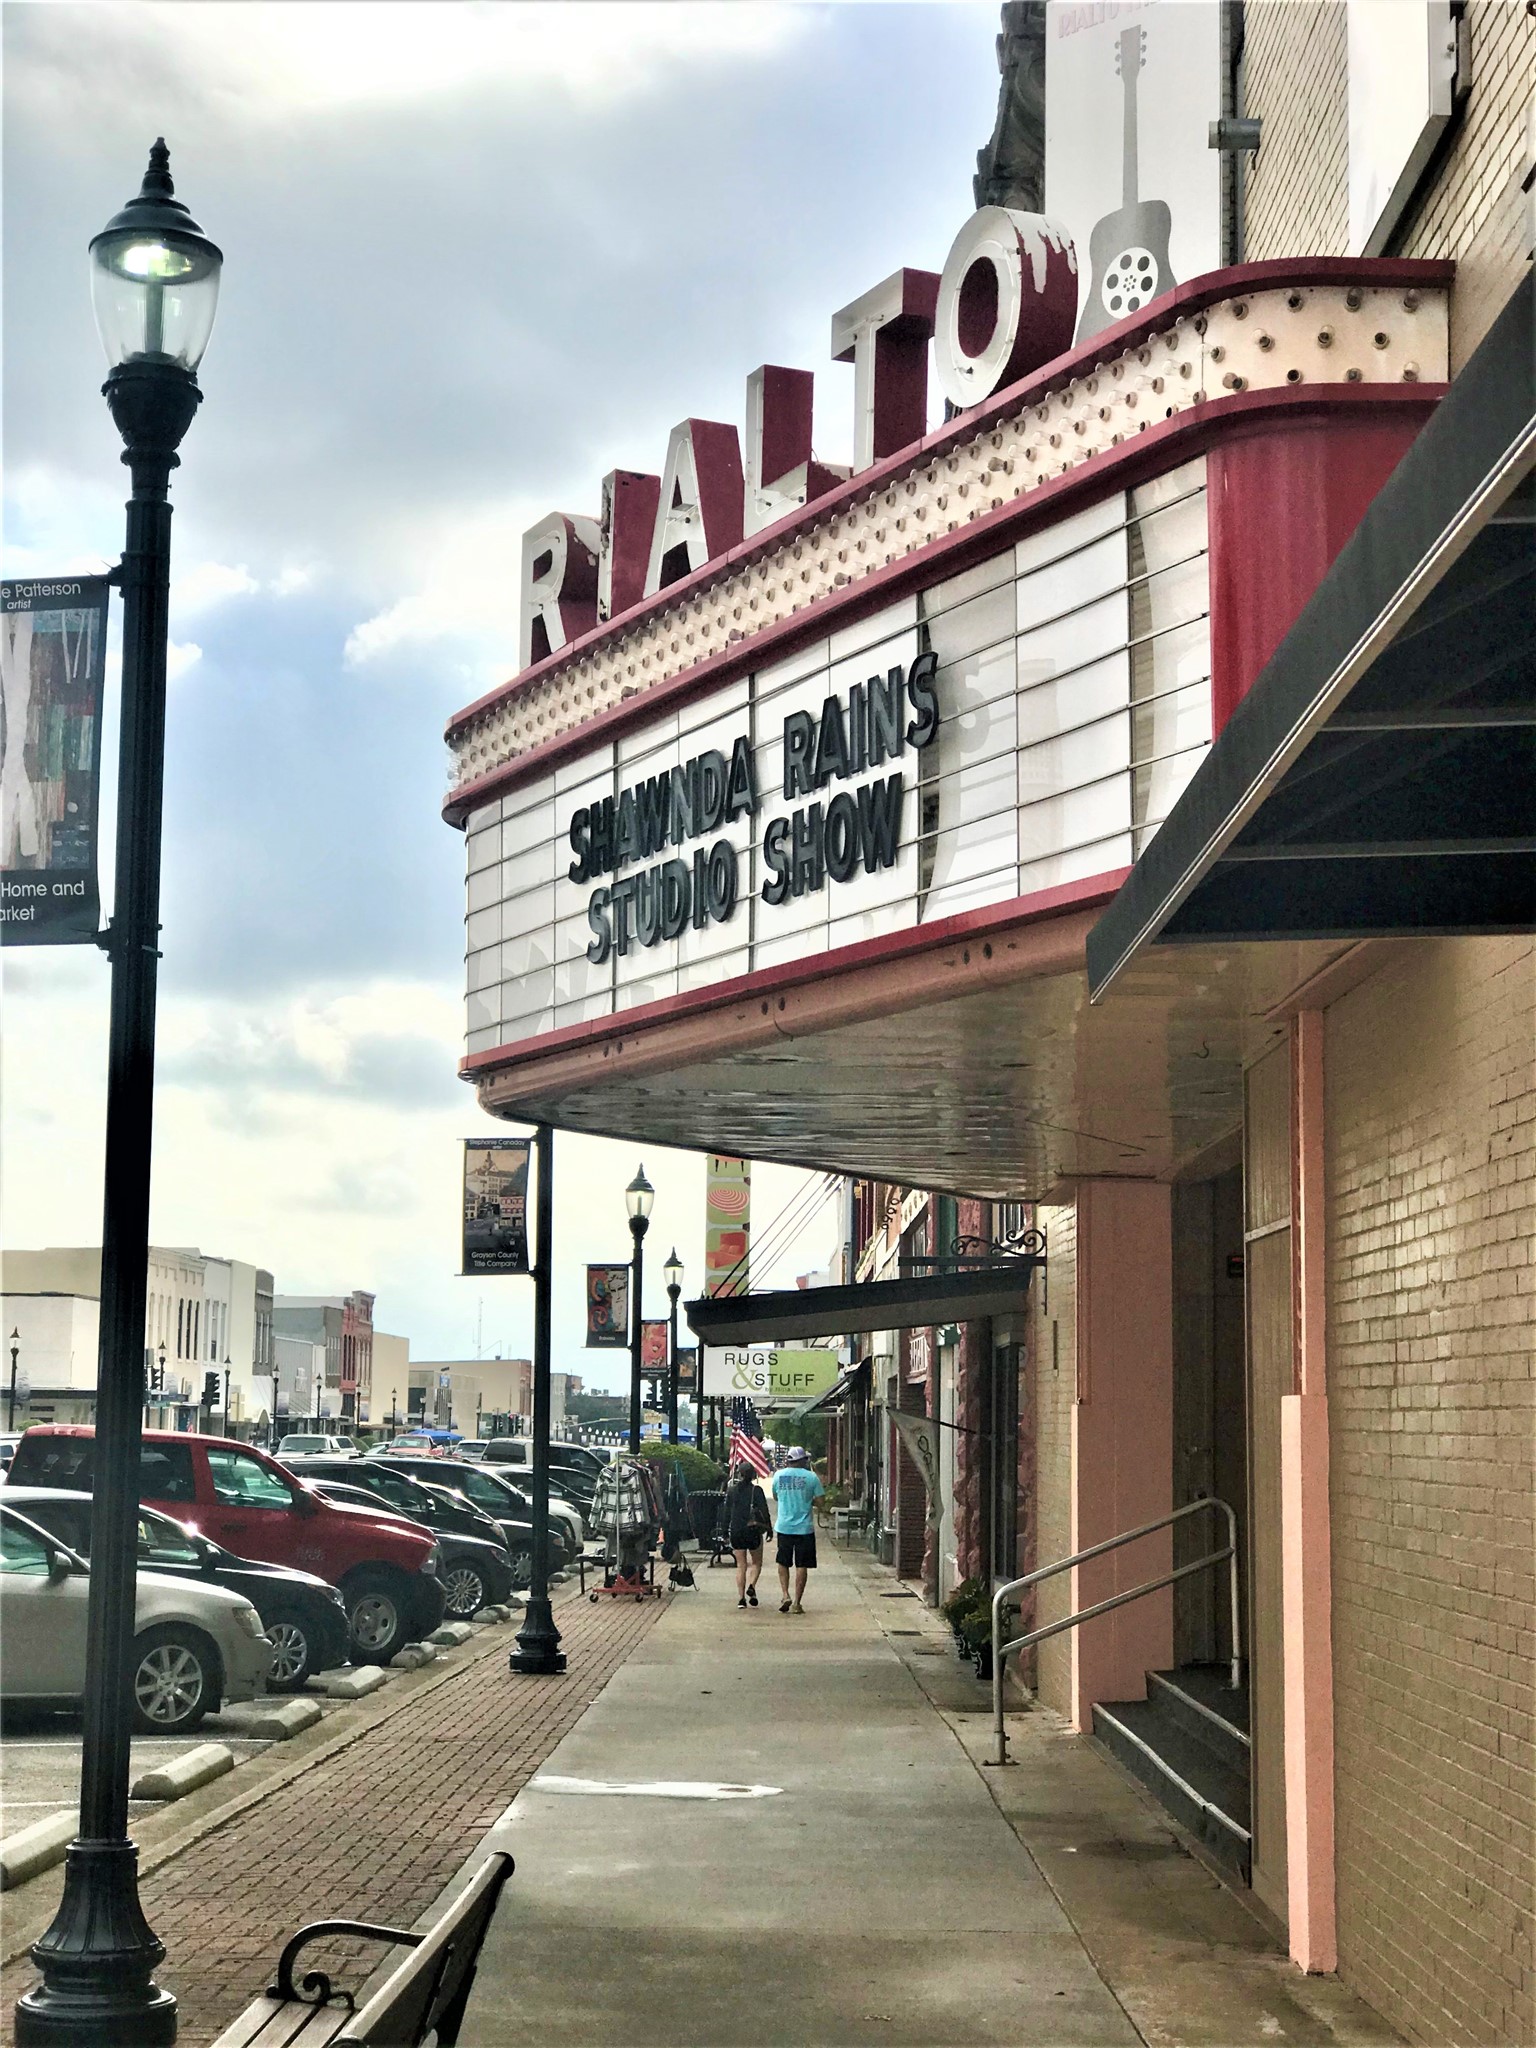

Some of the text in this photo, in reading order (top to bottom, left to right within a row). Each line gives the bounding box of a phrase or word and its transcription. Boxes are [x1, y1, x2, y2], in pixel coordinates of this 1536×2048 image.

[519, 205, 1078, 671] RIALTO
[0, 583, 81, 598] e Patterson
[6, 599, 31, 609] artist
[568, 651, 939, 884] SHAWNDA RAINS
[586, 771, 902, 965] STUDIO SHOW
[1, 880, 84, 897] Home and
[471, 1251, 519, 1259] Grayson County
[724, 1353, 778, 1365] RUGS
[732, 1358, 815, 1391] & STUFF
